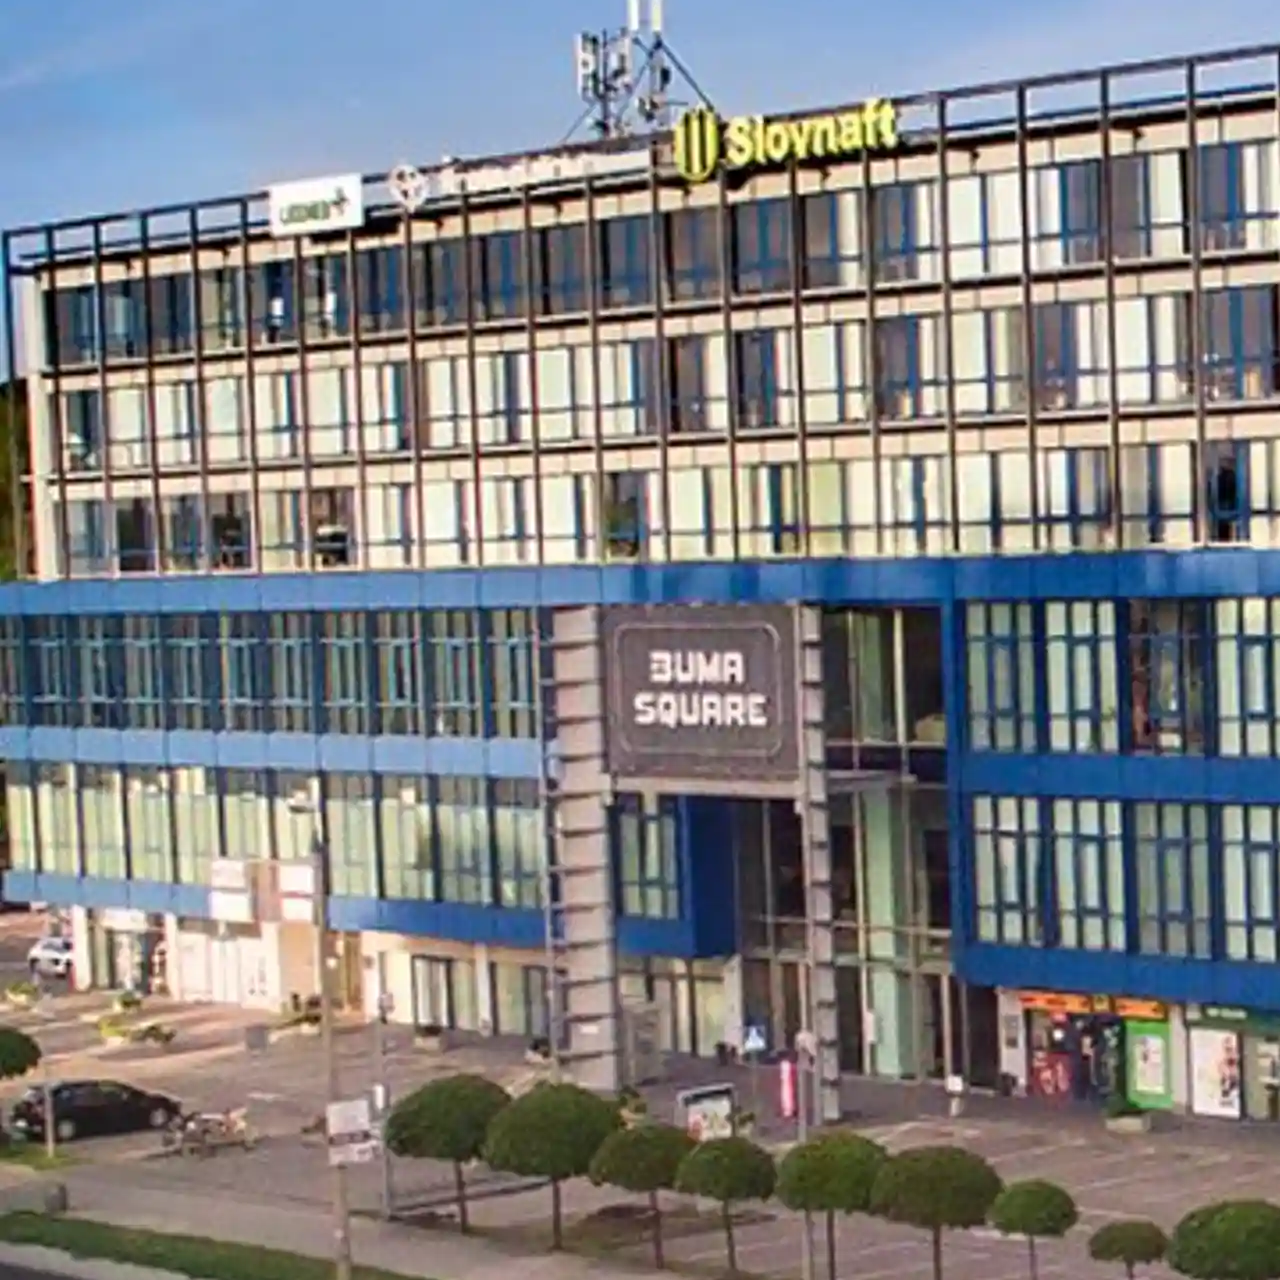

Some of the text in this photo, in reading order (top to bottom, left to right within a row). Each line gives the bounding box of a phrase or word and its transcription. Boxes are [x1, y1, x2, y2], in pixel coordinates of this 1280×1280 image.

[726, 96, 896, 166] Slovnaft
[649, 650, 744, 684] BUMA
[633, 692, 768, 728] SQUARE
